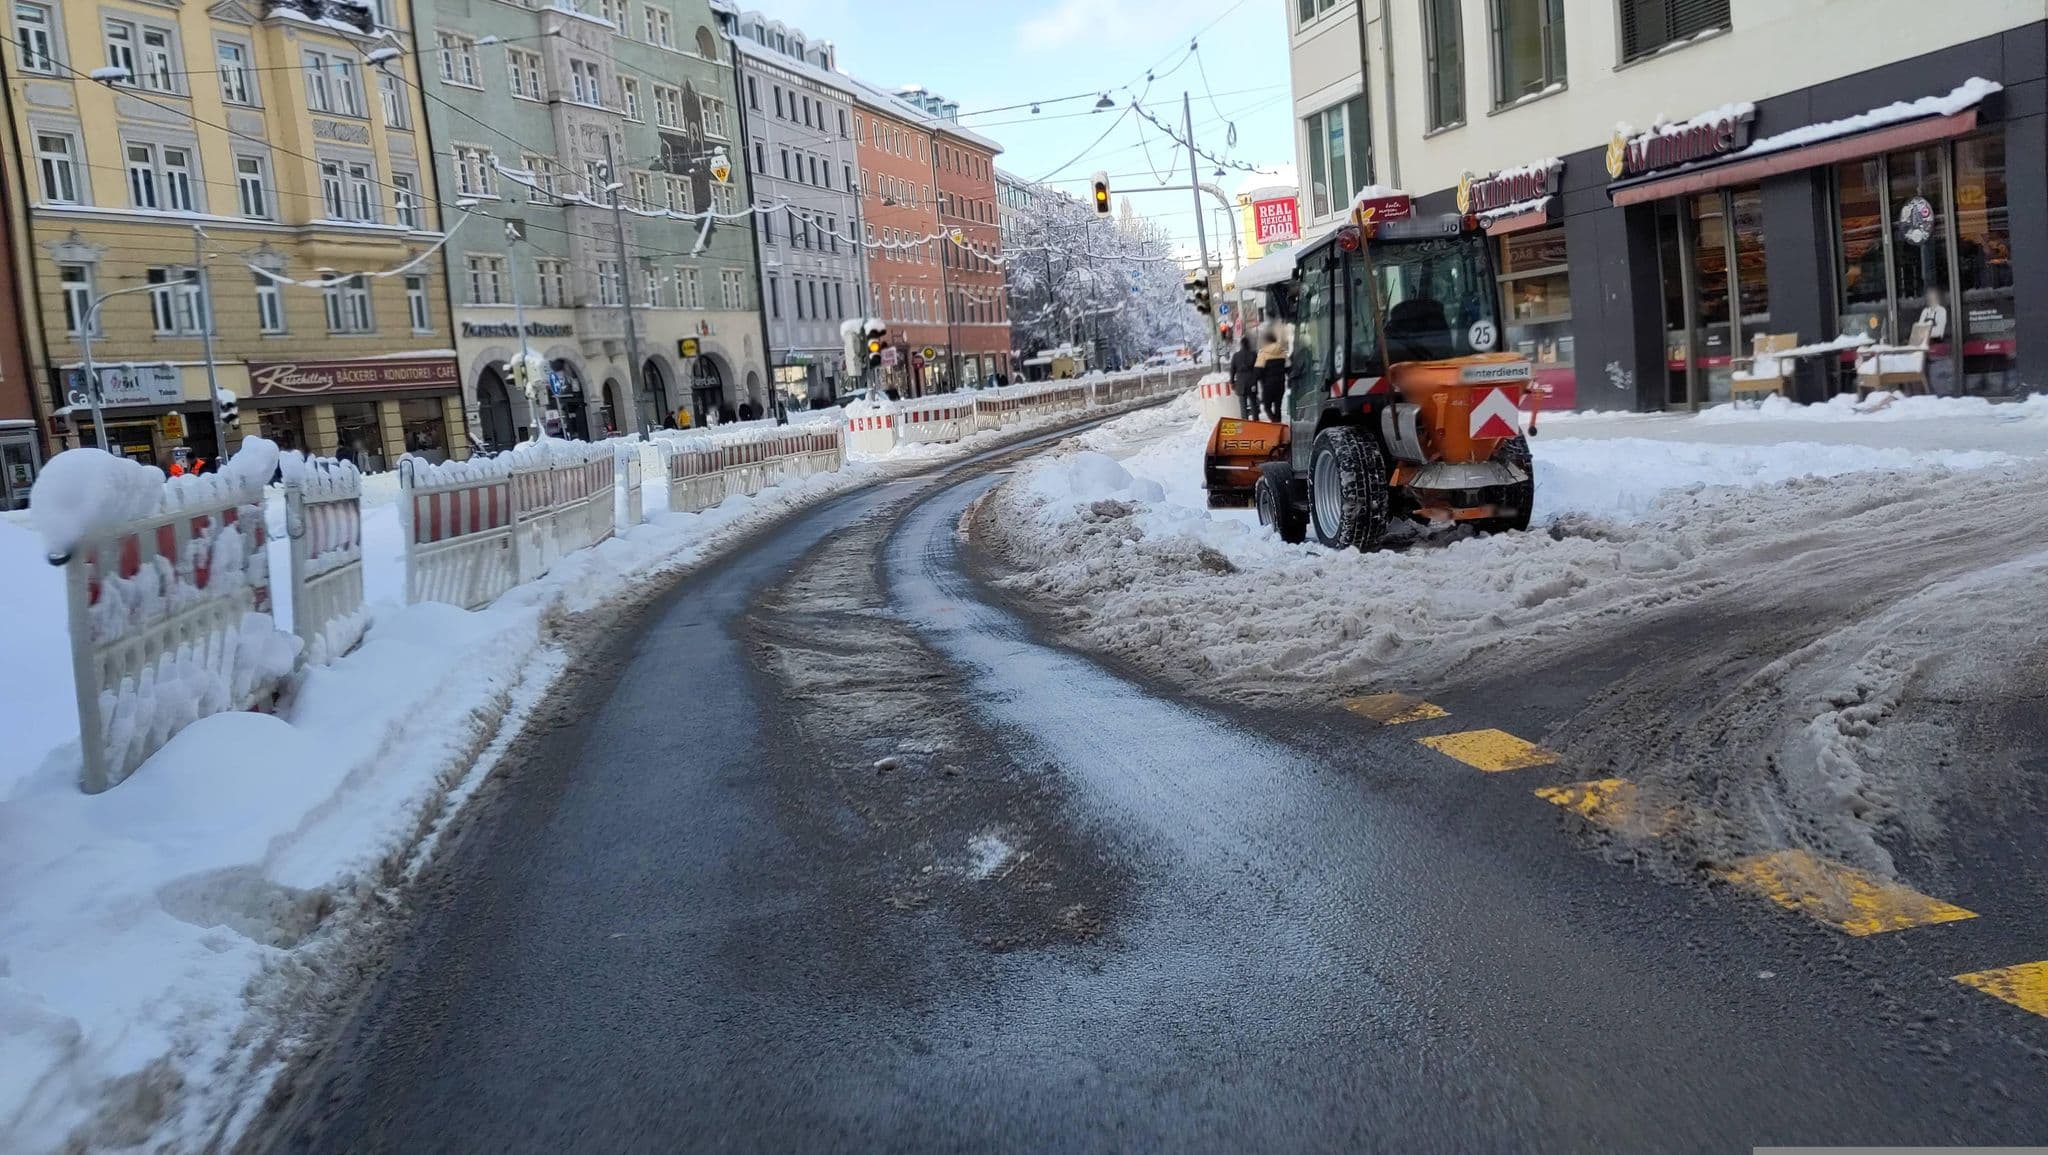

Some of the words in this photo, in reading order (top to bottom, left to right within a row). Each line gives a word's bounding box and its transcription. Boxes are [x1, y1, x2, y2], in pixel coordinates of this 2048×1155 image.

[1259, 203, 1291, 217] REAL
[1260, 215, 1293, 226] MEXICAN
[1262, 223, 1294, 237] FOOD
[1474, 327, 1490, 344] 25
[383, 367, 432, 380] KONDITOREI
[1224, 440, 1264, 449] ISEKI
